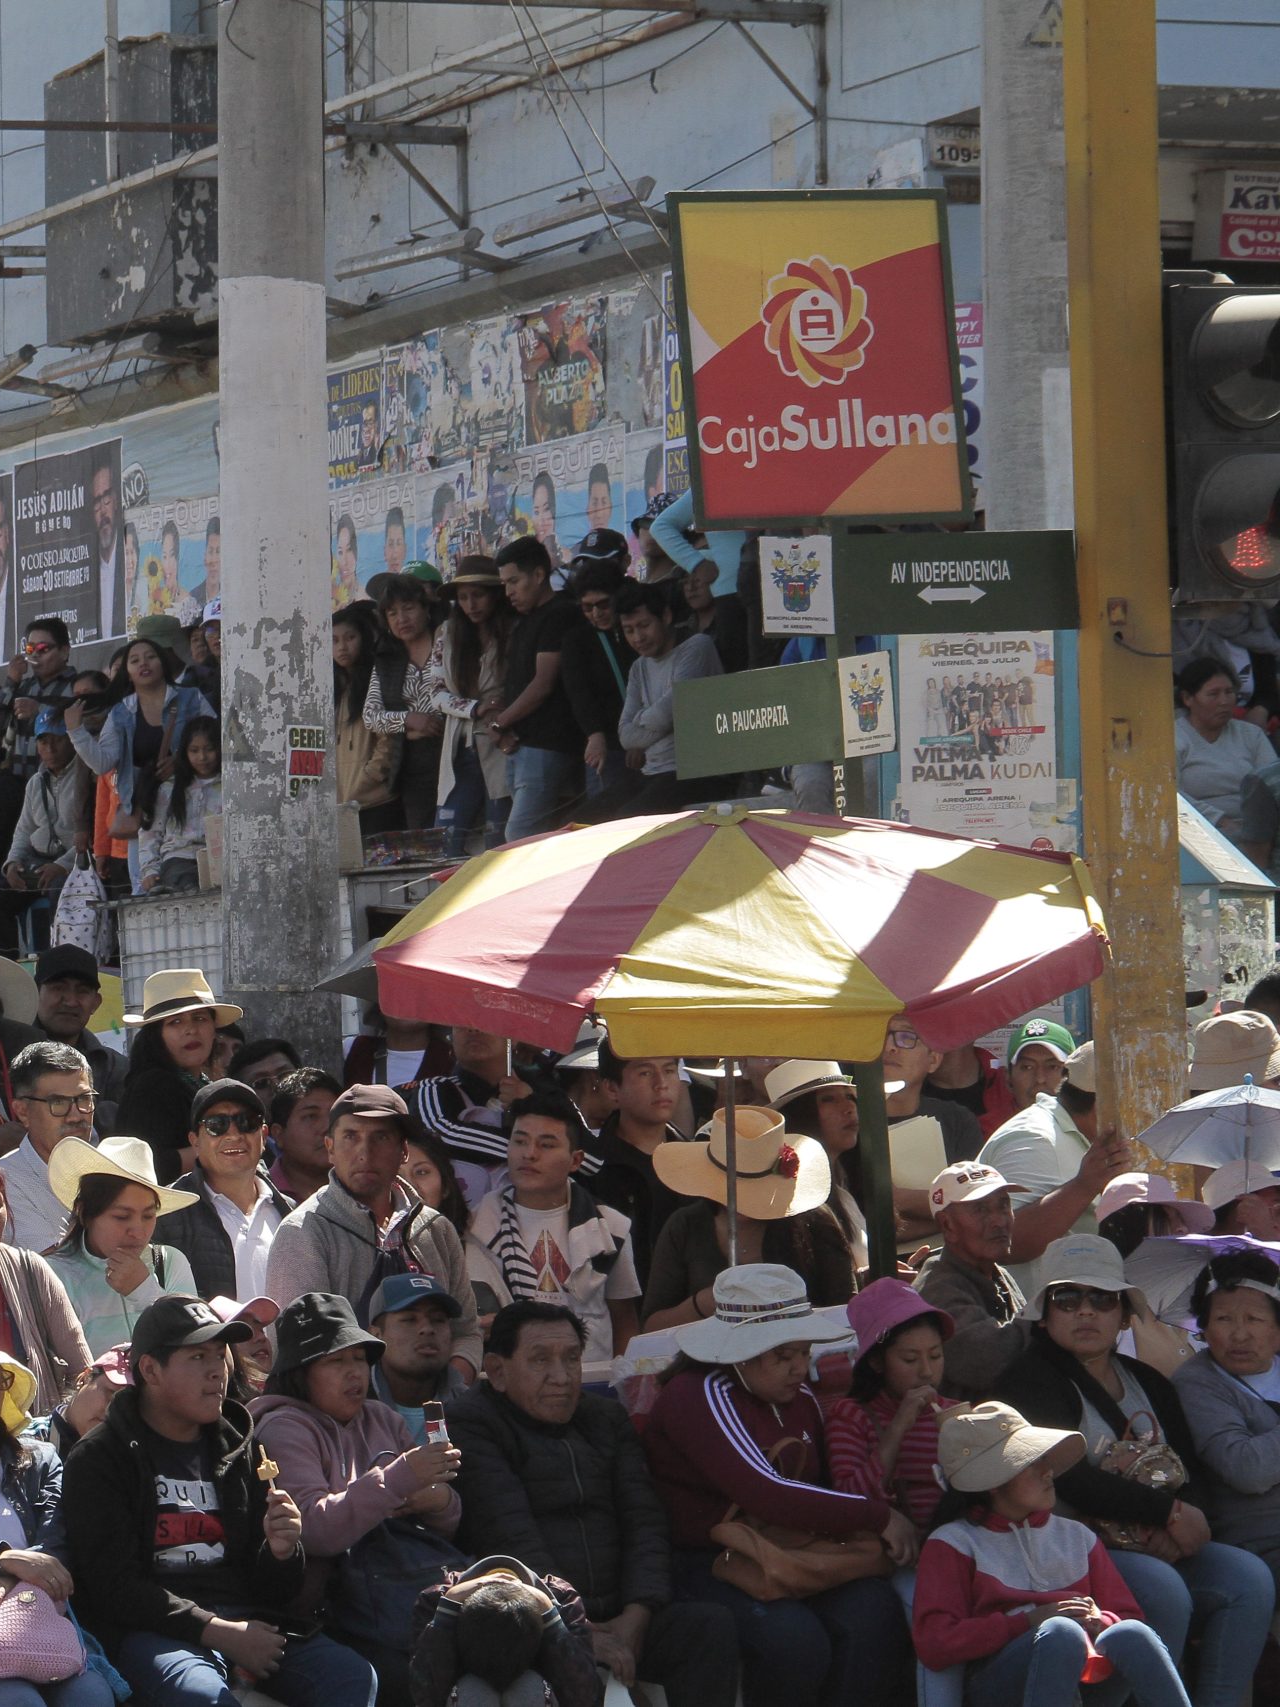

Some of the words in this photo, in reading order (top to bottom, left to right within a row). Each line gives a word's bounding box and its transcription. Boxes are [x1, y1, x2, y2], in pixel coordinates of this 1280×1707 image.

[342, 367, 380, 400] LÍDERES
[537, 359, 590, 386] ALBERTO
[546, 382, 584, 406] PLAZA
[22, 573, 43, 594] SÁBADO
[43, 570, 53, 592] 30
[891, 562, 907, 583] AV
[911, 559, 1011, 583] INDEPENDENCIA
[715, 713, 729, 734] CA
[732, 704, 790, 732] PAUCARPATA
[913, 745, 983, 764] VILMA
[912, 764, 985, 782] PALMA
[991, 762, 1052, 780] KUDAI
